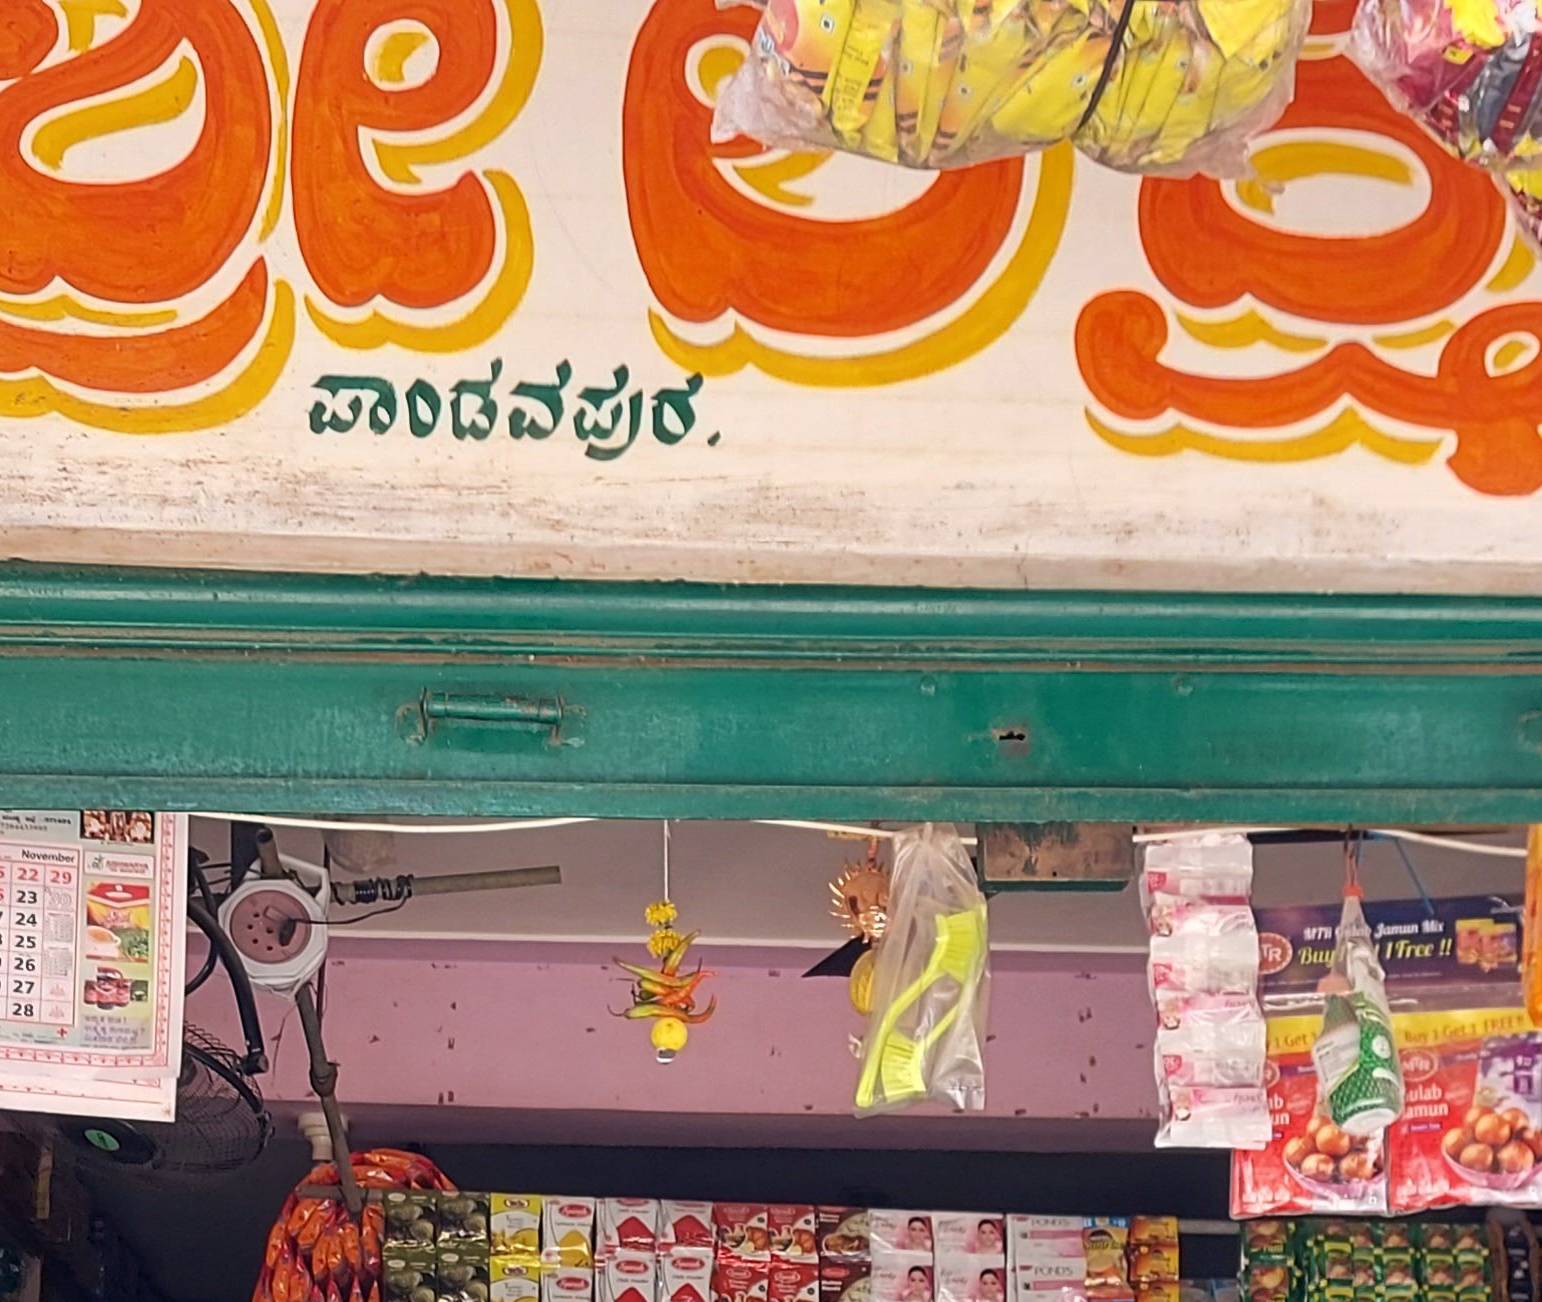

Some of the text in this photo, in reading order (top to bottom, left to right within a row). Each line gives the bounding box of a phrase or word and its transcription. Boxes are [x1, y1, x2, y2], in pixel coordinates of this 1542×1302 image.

[21, 850, 75, 863] November
[17, 868, 39, 881] 22
[51, 871, 72, 883] 29
[17, 891, 37, 903] 23
[15, 913, 37, 925] 24
[1374, 921, 1418, 939] Jamun
[1421, 920, 1444, 934] Mix
[15, 935, 36, 948] 25
[1259, 945, 1282, 961] TR
[1298, 948, 1336, 968] Buy
[14, 958, 35, 971] 26
[13, 980, 34, 993] 27
[12, 1003, 34, 1016] 28
[1405, 1084, 1442, 1101] ulab
[1405, 1103, 1448, 1118] amun
